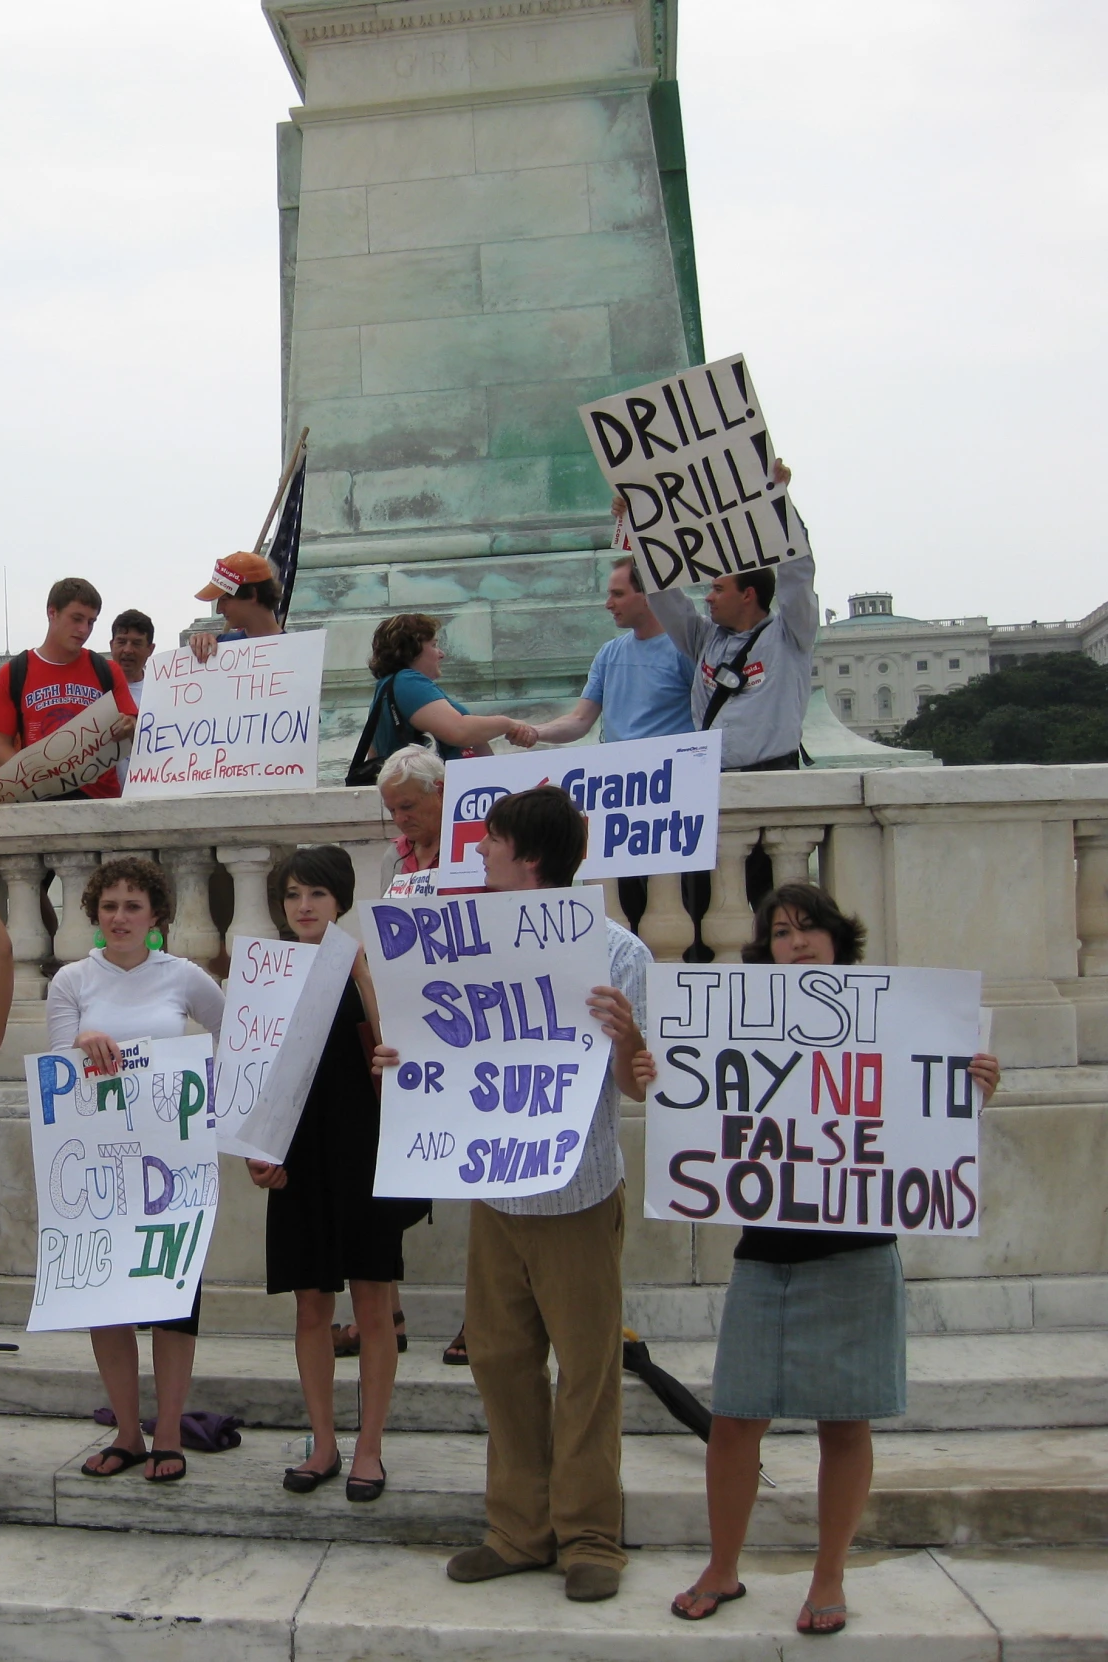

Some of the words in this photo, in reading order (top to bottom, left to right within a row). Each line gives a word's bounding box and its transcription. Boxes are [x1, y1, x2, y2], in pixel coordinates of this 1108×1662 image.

[394, 39, 546, 78] GRANT
[590, 360, 756, 468] DRILL!
[614, 429, 775, 532] DRILL!
[637, 495, 796, 590] DRILL!
[152, 643, 278, 681] WELCOME
[170, 683, 203, 706] TO
[227, 671, 294, 700] THE
[25, 683, 60, 708] BETH
[18, 719, 121, 792] IGNORANCE
[136, 706, 311, 755] REVOLUTION
[60, 741, 121, 793] NOW
[561, 759, 673, 812] Grand
[604, 810, 704, 857] Party
[372, 899, 491, 964] DRILL
[514, 899, 594, 949] AND
[242, 941, 296, 985] SAVE
[229, 1005, 285, 1052] SAVE
[421, 974, 593, 1051] SPILL,
[660, 970, 890, 1047] JUST
[122, 1057, 150, 1071] Party
[397, 1061, 444, 1094] OR
[469, 1061, 579, 1117] SURF
[654, 1045, 803, 1113] SAY
[811, 1051, 882, 1117] NO
[911, 1054, 973, 1118] TO
[407, 1131, 456, 1161] AND
[458, 1129, 580, 1184] SWIM?
[721, 1114, 885, 1166] FALSE
[49, 1138, 142, 1220] CUT
[668, 1149, 977, 1231] SOLUTIONS
[36, 1228, 113, 1306] PLUG
[128, 1209, 204, 1290] IN!
